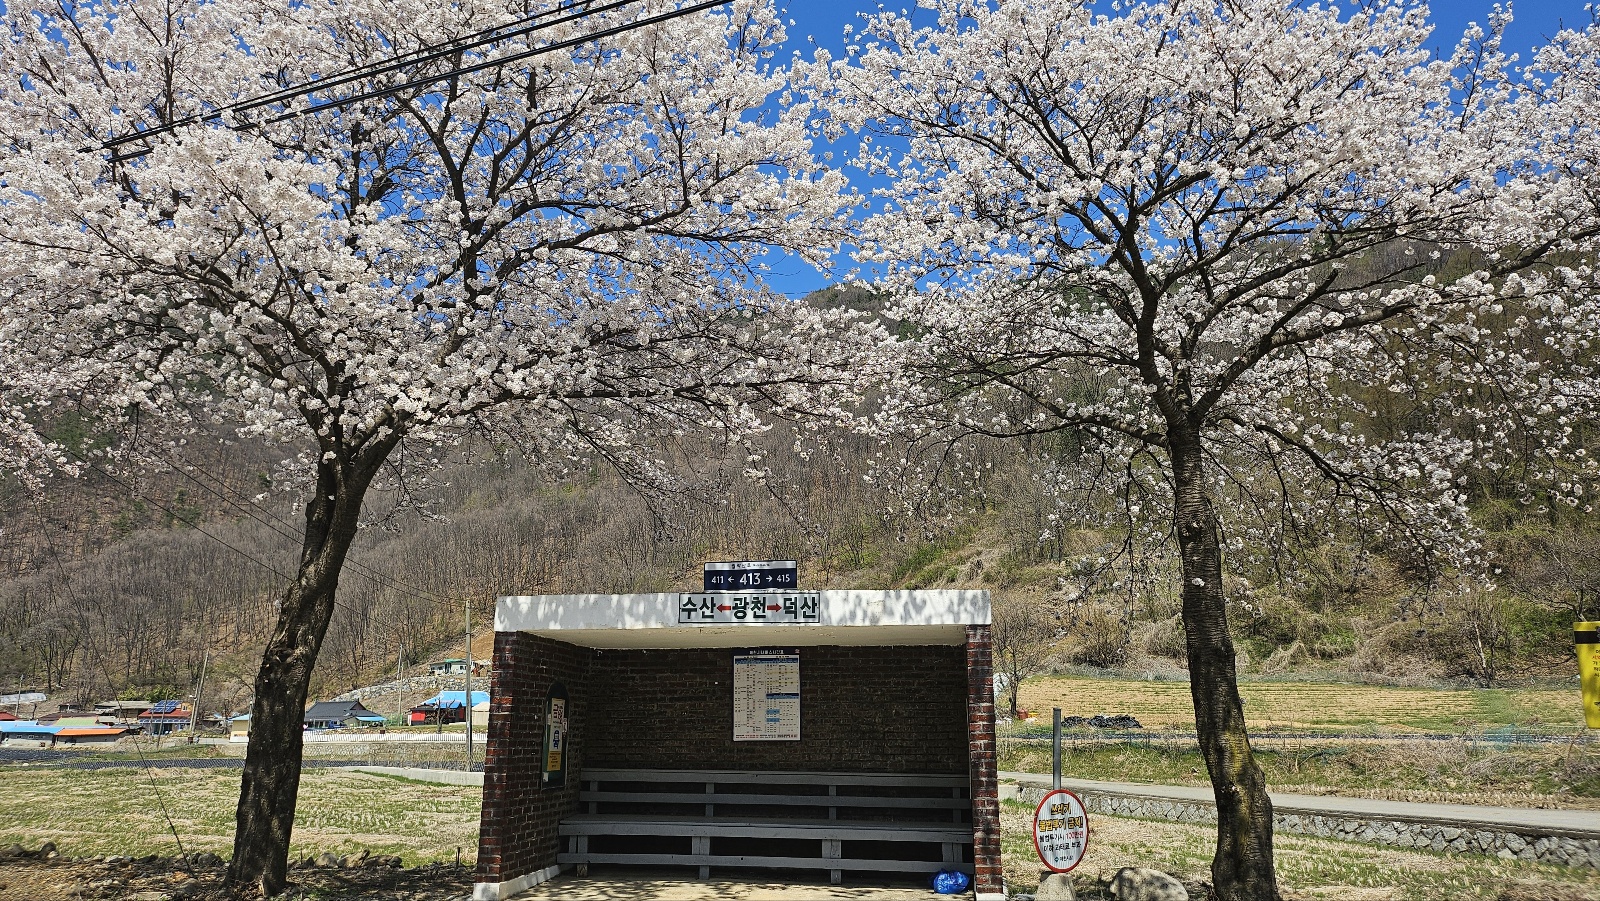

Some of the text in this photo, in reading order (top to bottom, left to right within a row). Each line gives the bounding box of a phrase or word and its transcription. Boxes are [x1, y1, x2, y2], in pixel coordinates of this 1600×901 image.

[711, 572, 791, 585] 411 413 415
[681, 596, 818, 619] 수산 광천 덕산
[1051, 802, 1071, 815] 쓰레기
[1039, 819, 1066, 832] 불법투기
